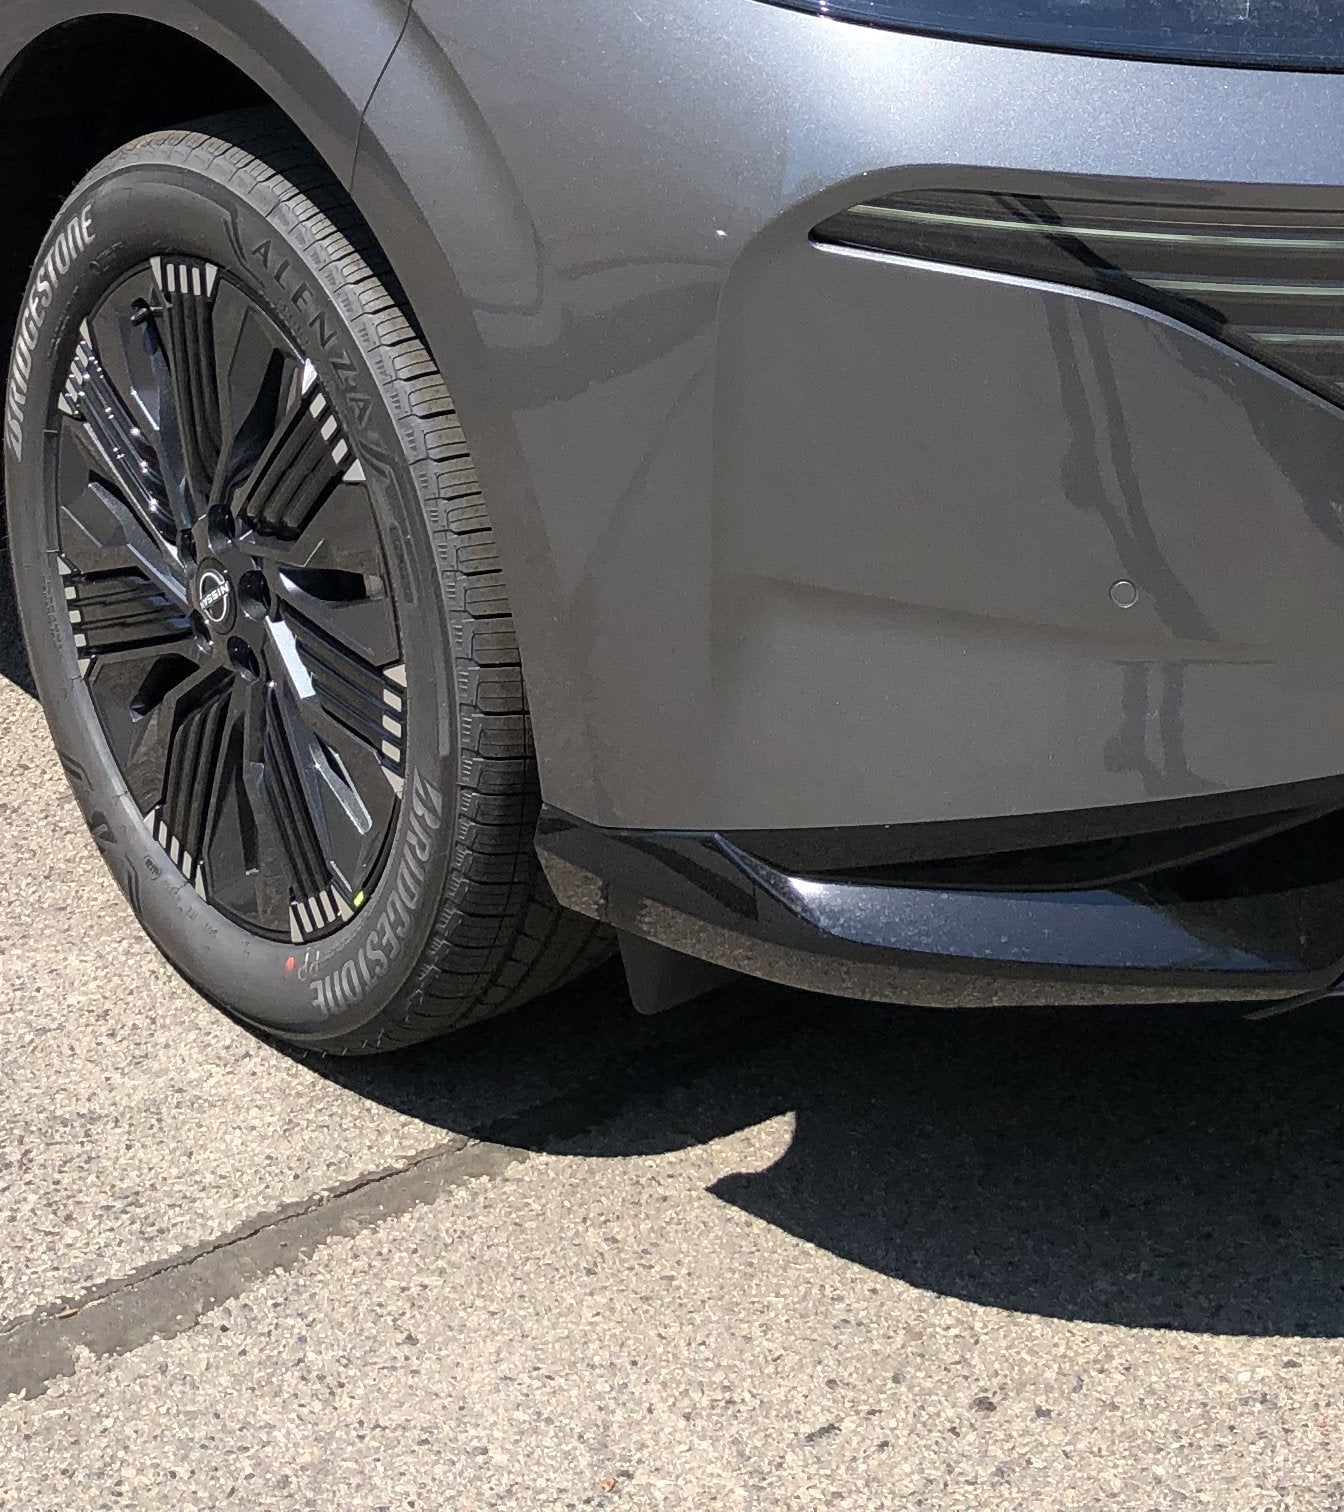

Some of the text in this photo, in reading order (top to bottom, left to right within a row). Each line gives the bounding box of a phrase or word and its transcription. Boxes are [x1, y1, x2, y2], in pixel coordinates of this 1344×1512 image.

[6, 203, 96, 463] BRIDGESTONE
[252, 239, 373, 429] ALENZA
[309, 765, 443, 1018] BRIDGESTONE
